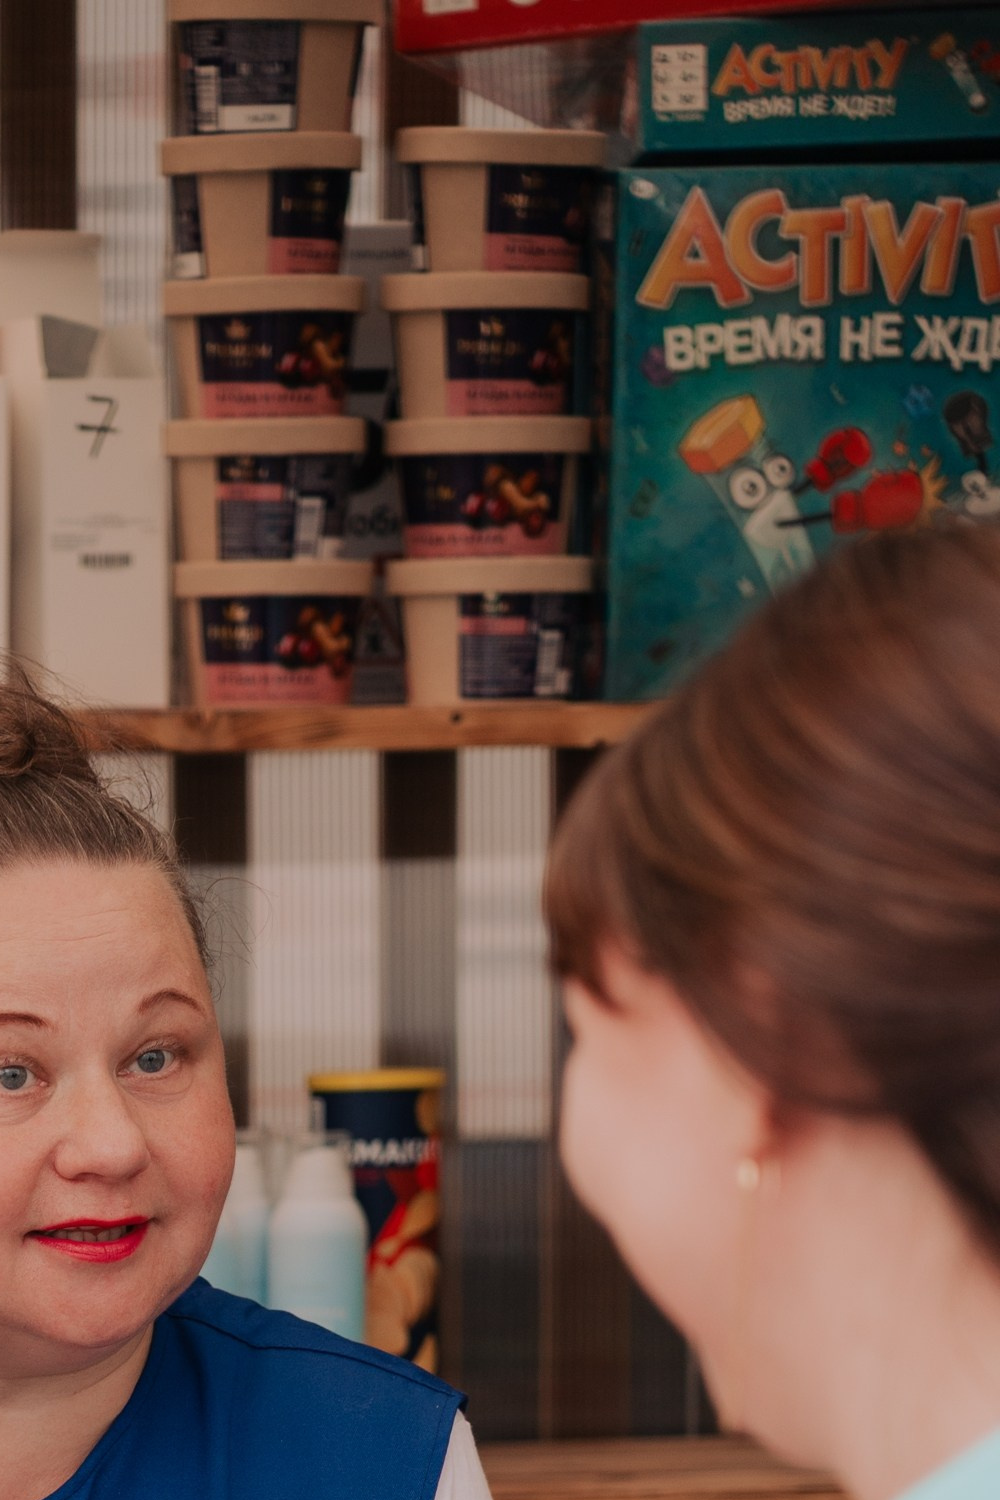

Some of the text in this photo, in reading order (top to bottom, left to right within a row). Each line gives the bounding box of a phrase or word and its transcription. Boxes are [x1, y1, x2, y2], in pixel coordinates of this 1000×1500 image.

[711, 38, 908, 95] ACTIVITY
[663, 313, 825, 371] ВРЕМЯ
[839, 311, 904, 362] НЕ
[75, 393, 120, 459] 7
